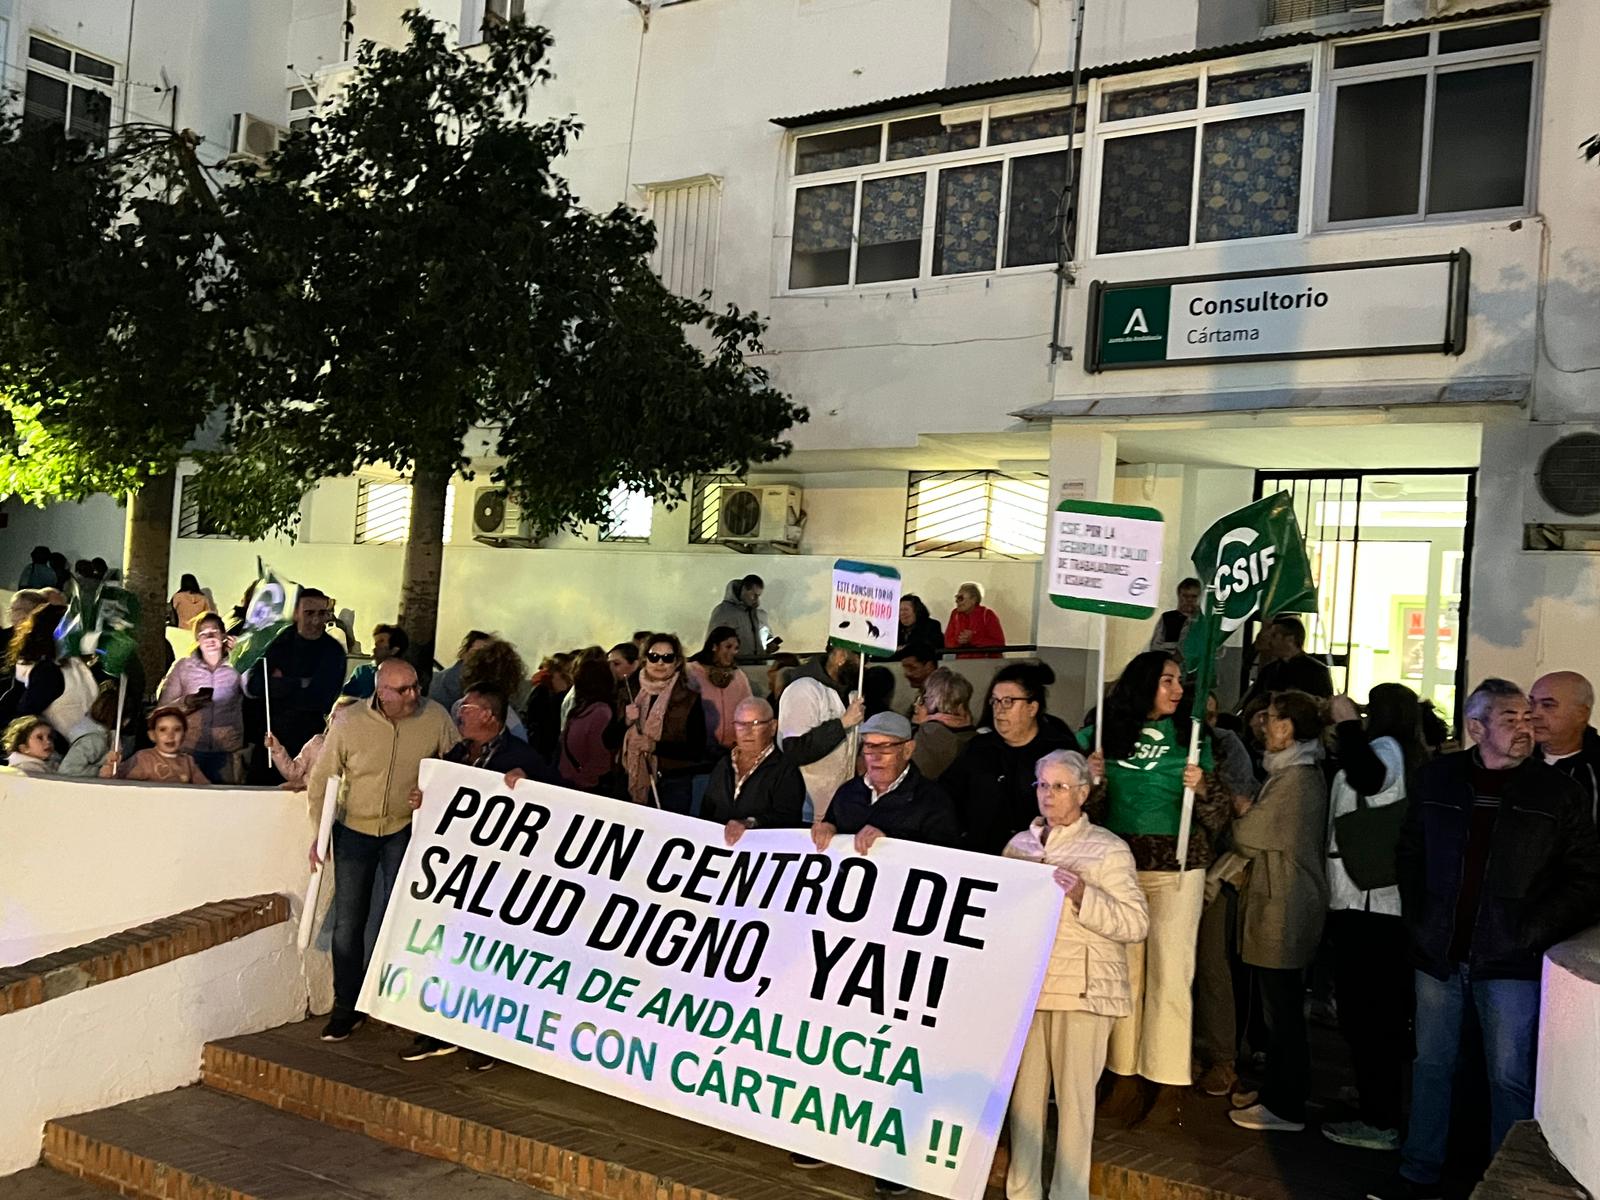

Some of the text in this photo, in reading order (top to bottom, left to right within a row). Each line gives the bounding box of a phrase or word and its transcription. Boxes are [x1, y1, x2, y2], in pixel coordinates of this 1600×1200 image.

[1189, 287, 1329, 316] Consultorio
[1187, 326, 1260, 344] Cártama
[836, 581, 893, 602] ESTE CONSULTORIO
[1214, 545, 1276, 601] CSIF
[836, 595, 893, 619] NO ES SEGURO
[435, 786, 999, 950] POR UN CENTRO DE
[410, 846, 949, 1028] SALUD DIGNO, YA!!
[406, 919, 924, 1094] LA JUNTA DE ANDALUCÍA
[418, 976, 563, 1051] CUMPLE
[570, 1021, 657, 1082] CON
[670, 1046, 908, 1157] CÁRTAMA
[926, 1119, 963, 1170] !!
